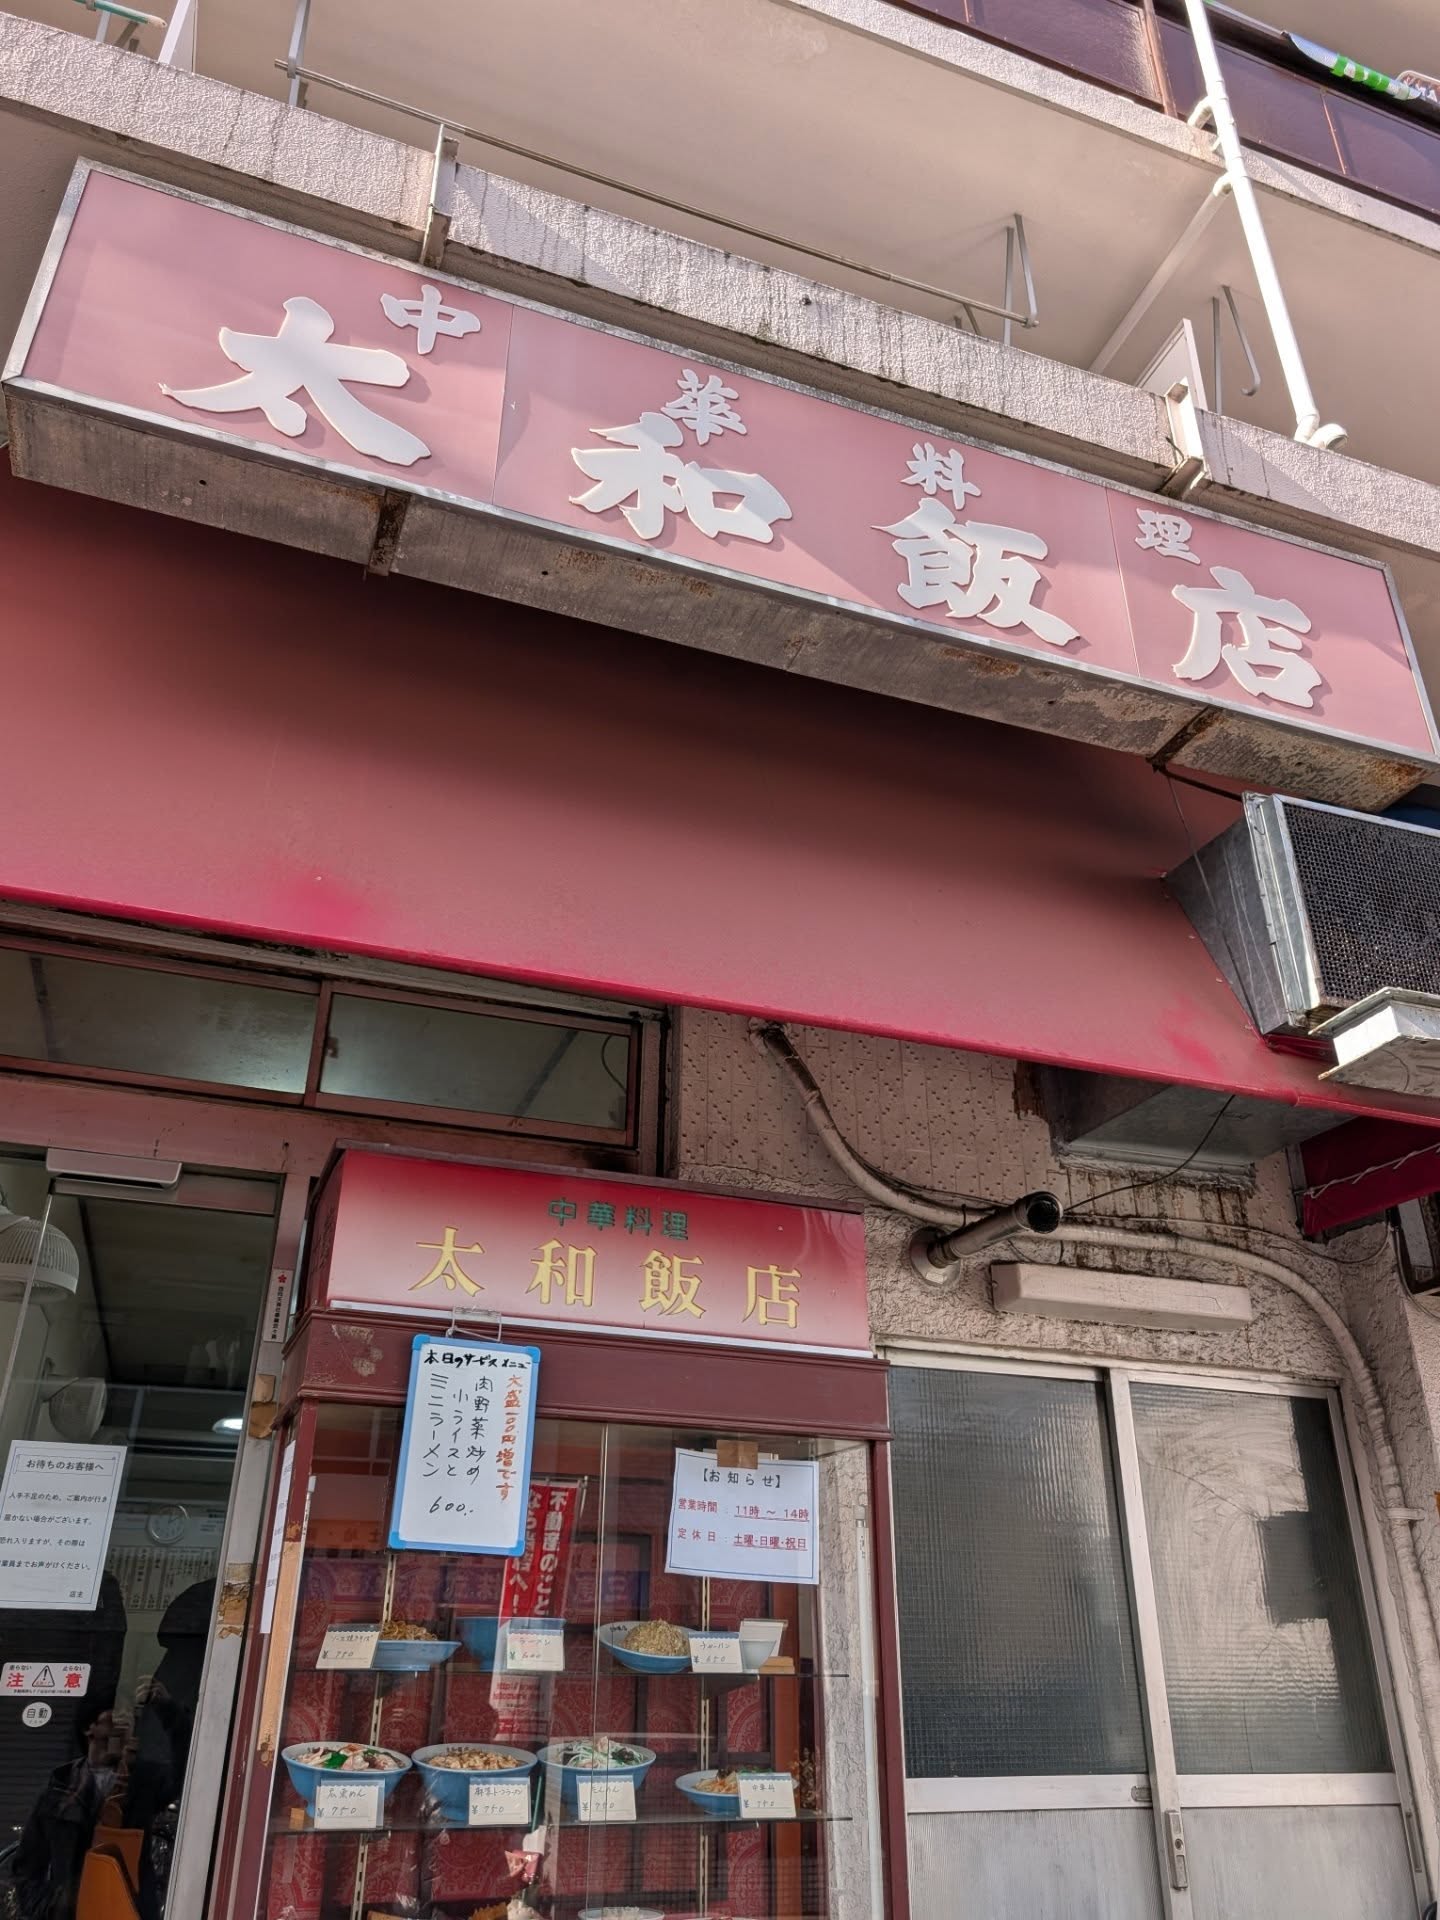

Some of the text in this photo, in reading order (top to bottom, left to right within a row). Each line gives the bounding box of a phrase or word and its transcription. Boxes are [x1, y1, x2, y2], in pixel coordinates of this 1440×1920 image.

[381, 284, 1200, 564] 中華料理
[158, 296, 1322, 708] 太和飯店
[548, 1197, 688, 1241] 中華料理
[408, 1226, 802, 1329] 太和飯店
[423, 1373, 449, 1477] ミニラーメン
[448, 1389, 468, 1477] 小ライスと
[466, 1376, 493, 1485] 肉野菜炒め
[26, 1459, 104, 1471] お待ちのお客様へ
[703, 1468, 781, 1488] 【お知らせ】
[678, 1498, 718, 1513] 営業時間
[0, 1560, 91, 1571] 業員までお声がけください。
[26, 1707, 49, 1719] 自動
